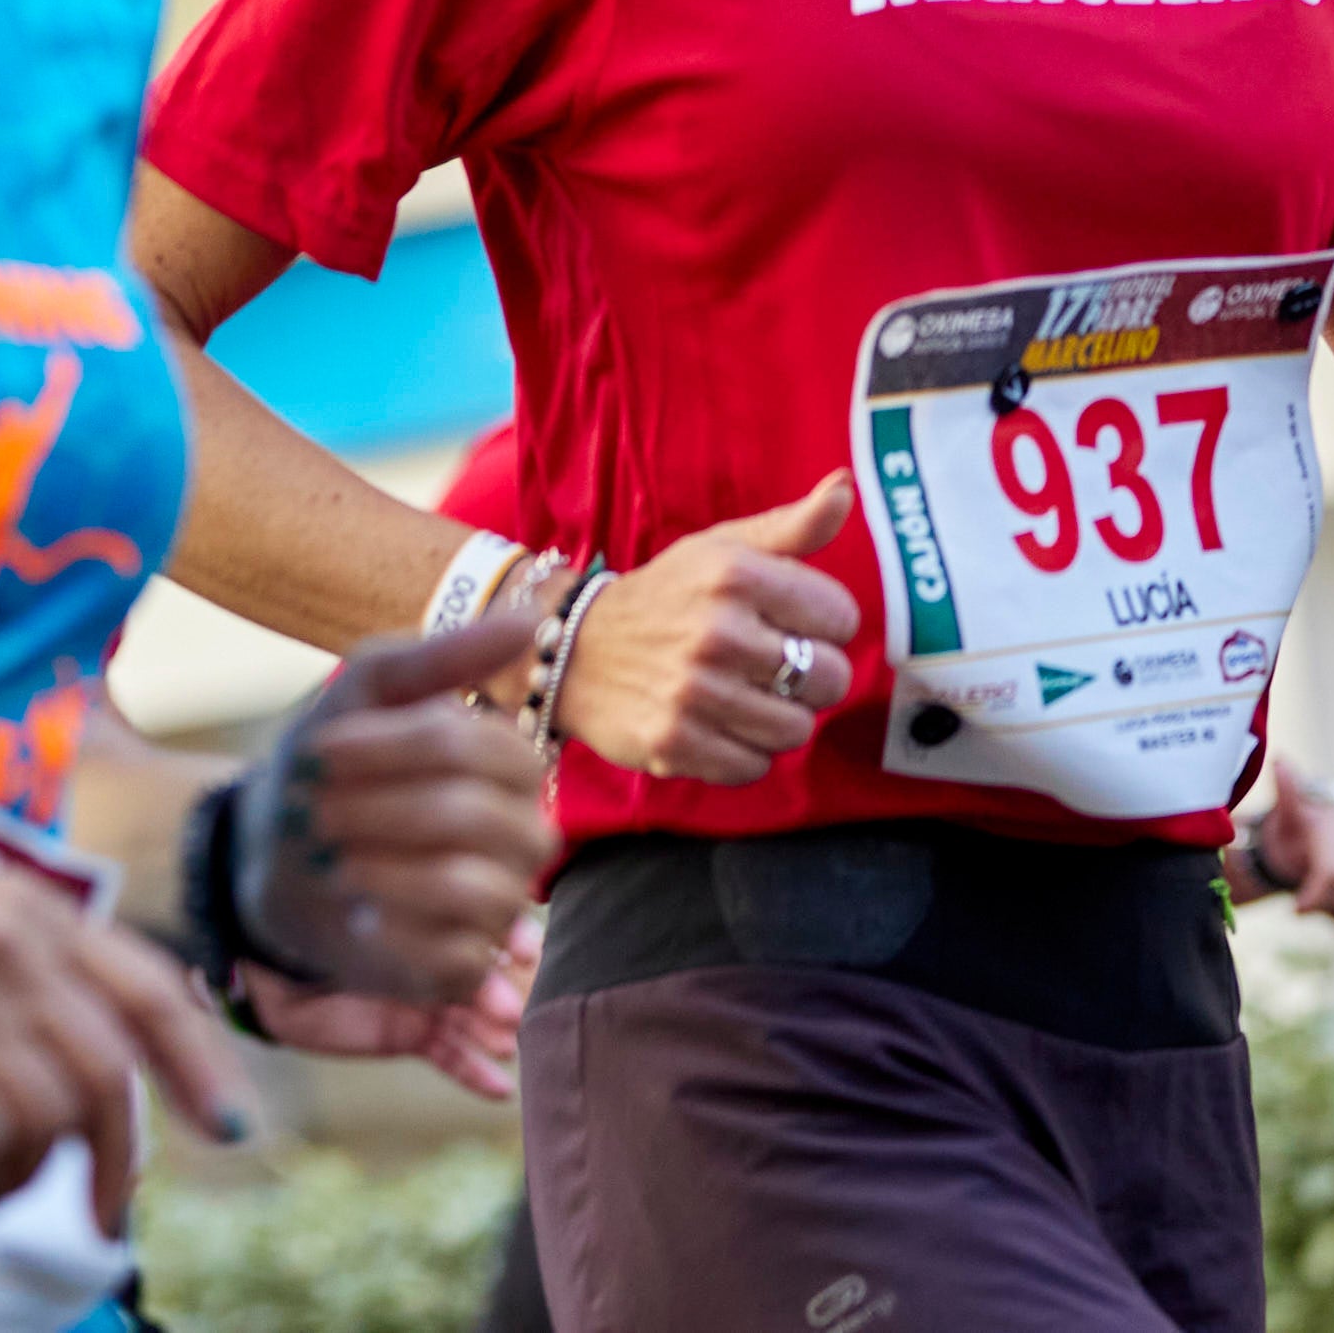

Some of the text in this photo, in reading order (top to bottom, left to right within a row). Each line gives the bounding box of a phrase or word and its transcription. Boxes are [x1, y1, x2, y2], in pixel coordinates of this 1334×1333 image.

[1019, 324, 1161, 374] MARCELINO
[882, 449, 915, 479] 3
[989, 384, 1230, 574] 937
[1105, 569, 1201, 627] LUCÍA
